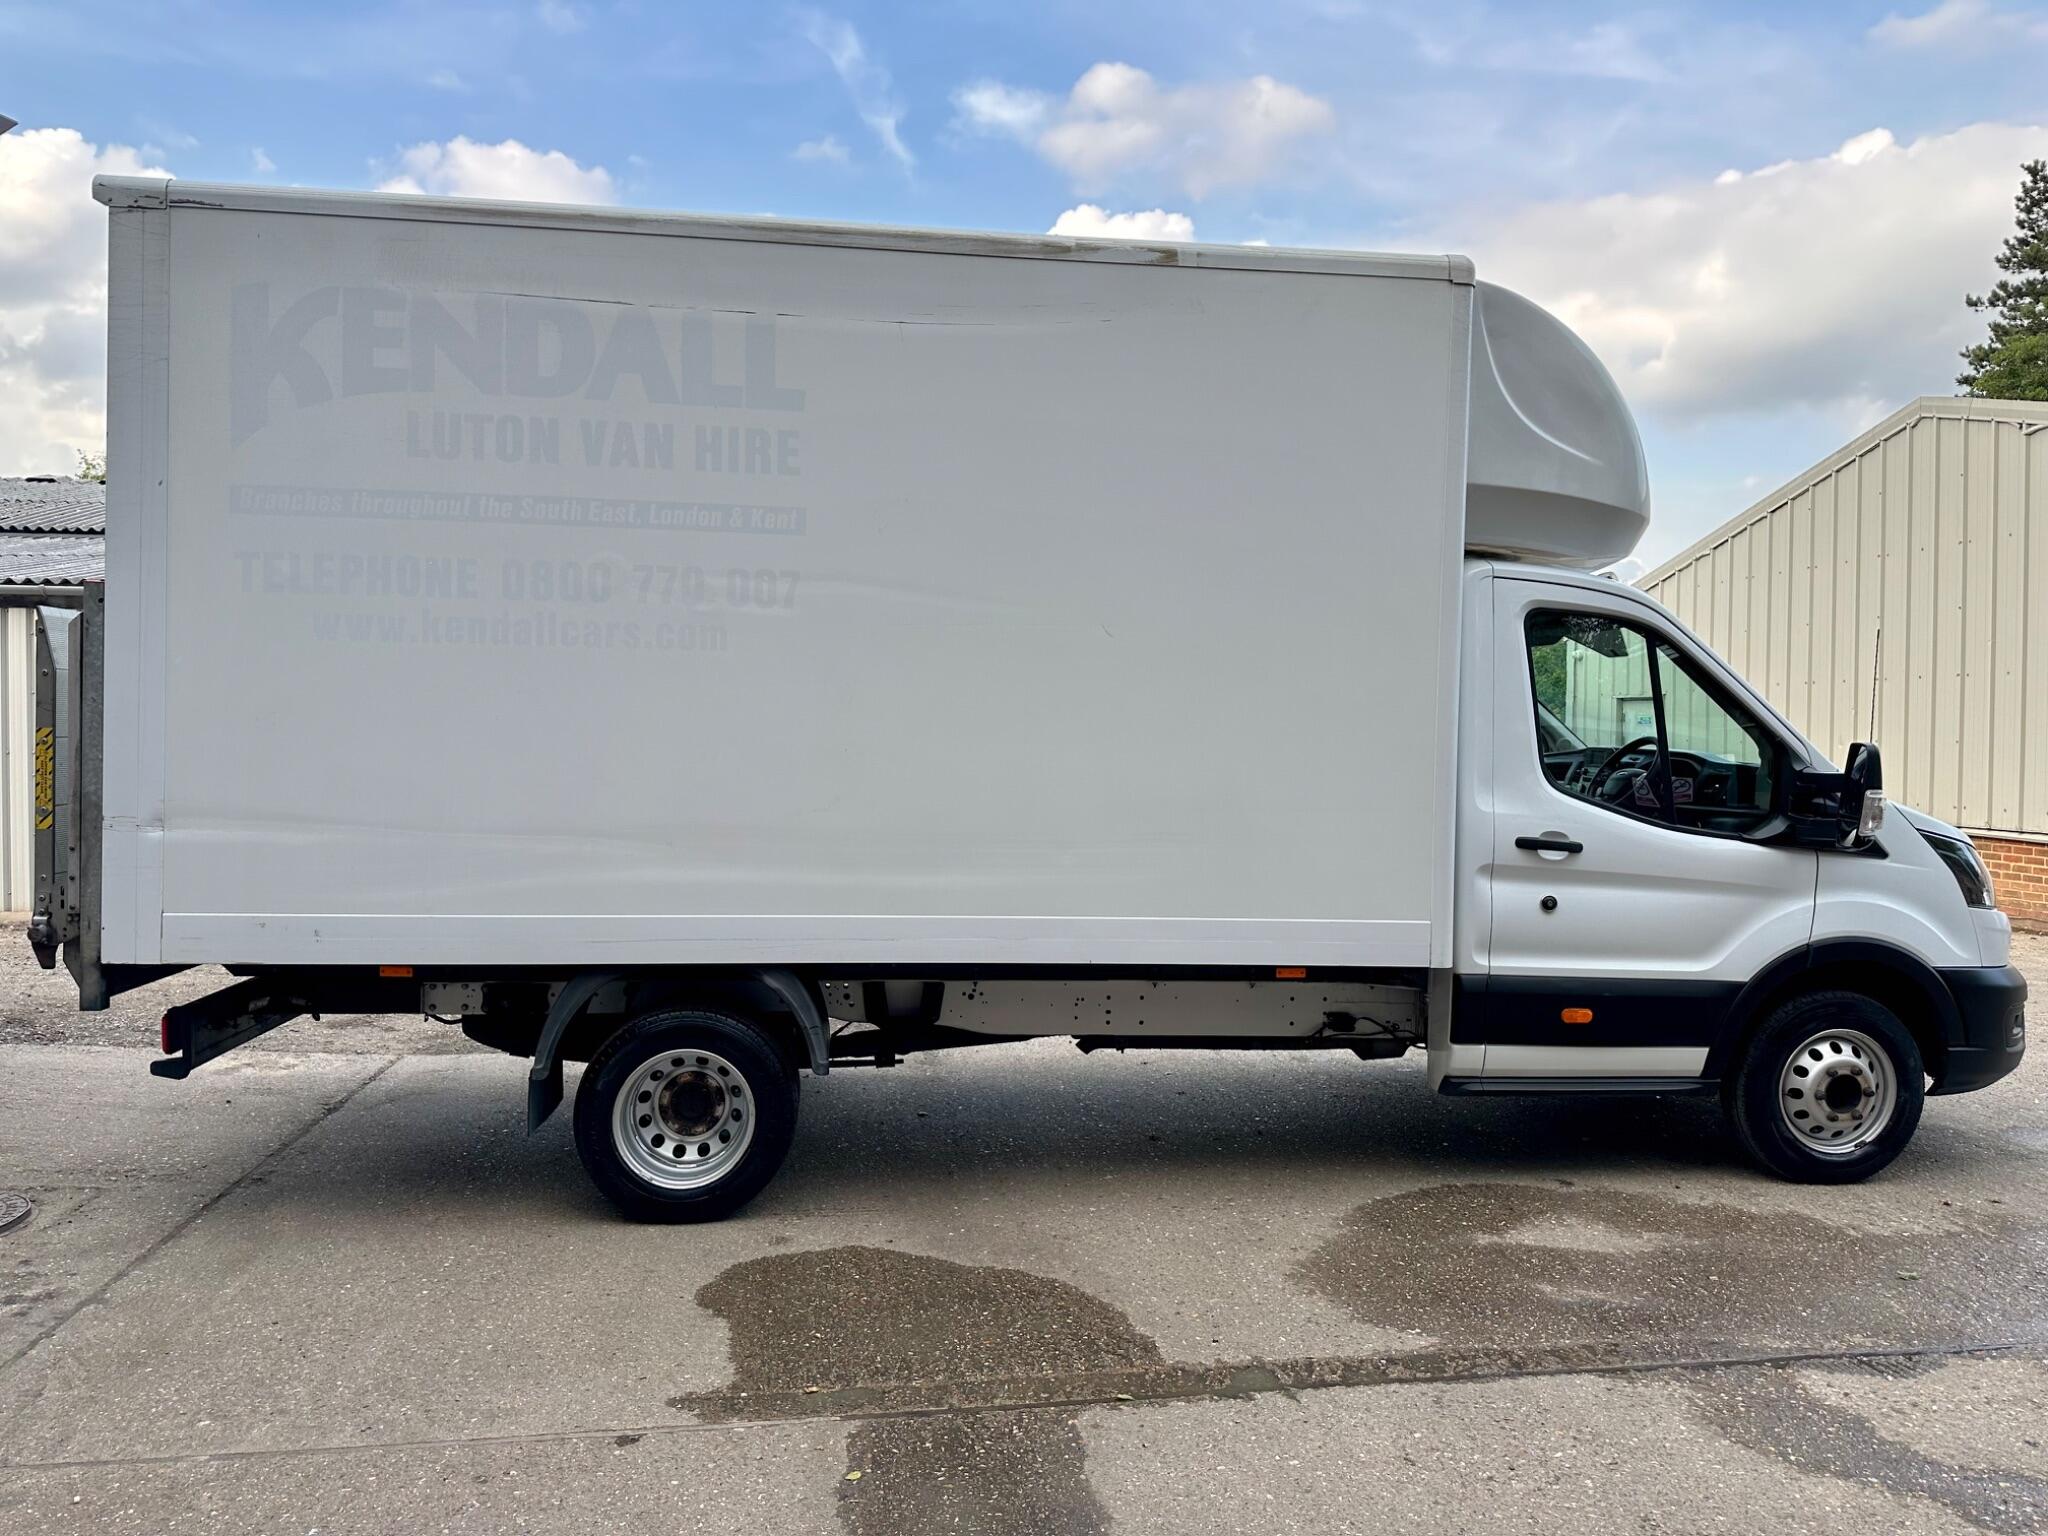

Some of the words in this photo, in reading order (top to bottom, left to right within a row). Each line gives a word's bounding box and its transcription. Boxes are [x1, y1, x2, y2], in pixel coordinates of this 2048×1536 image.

[231, 281, 806, 448] KENDALL
[407, 411, 559, 464] LUTON
[581, 417, 675, 469] VAN
[695, 424, 801, 476] HIRE
[239, 487, 343, 514] Branches
[351, 491, 471, 520] throughout
[479, 495, 513, 519] the
[519, 497, 581, 522] South
[588, 501, 642, 526] East,
[648, 503, 722, 529] London
[728, 507, 743, 529] &
[750, 507, 799, 530] Kent
[233, 551, 479, 599] TELEPHONE
[502, 558, 613, 605] 0800
[726, 568, 801, 609] 007
[313, 607, 727, 650] www.kendallcars.com
